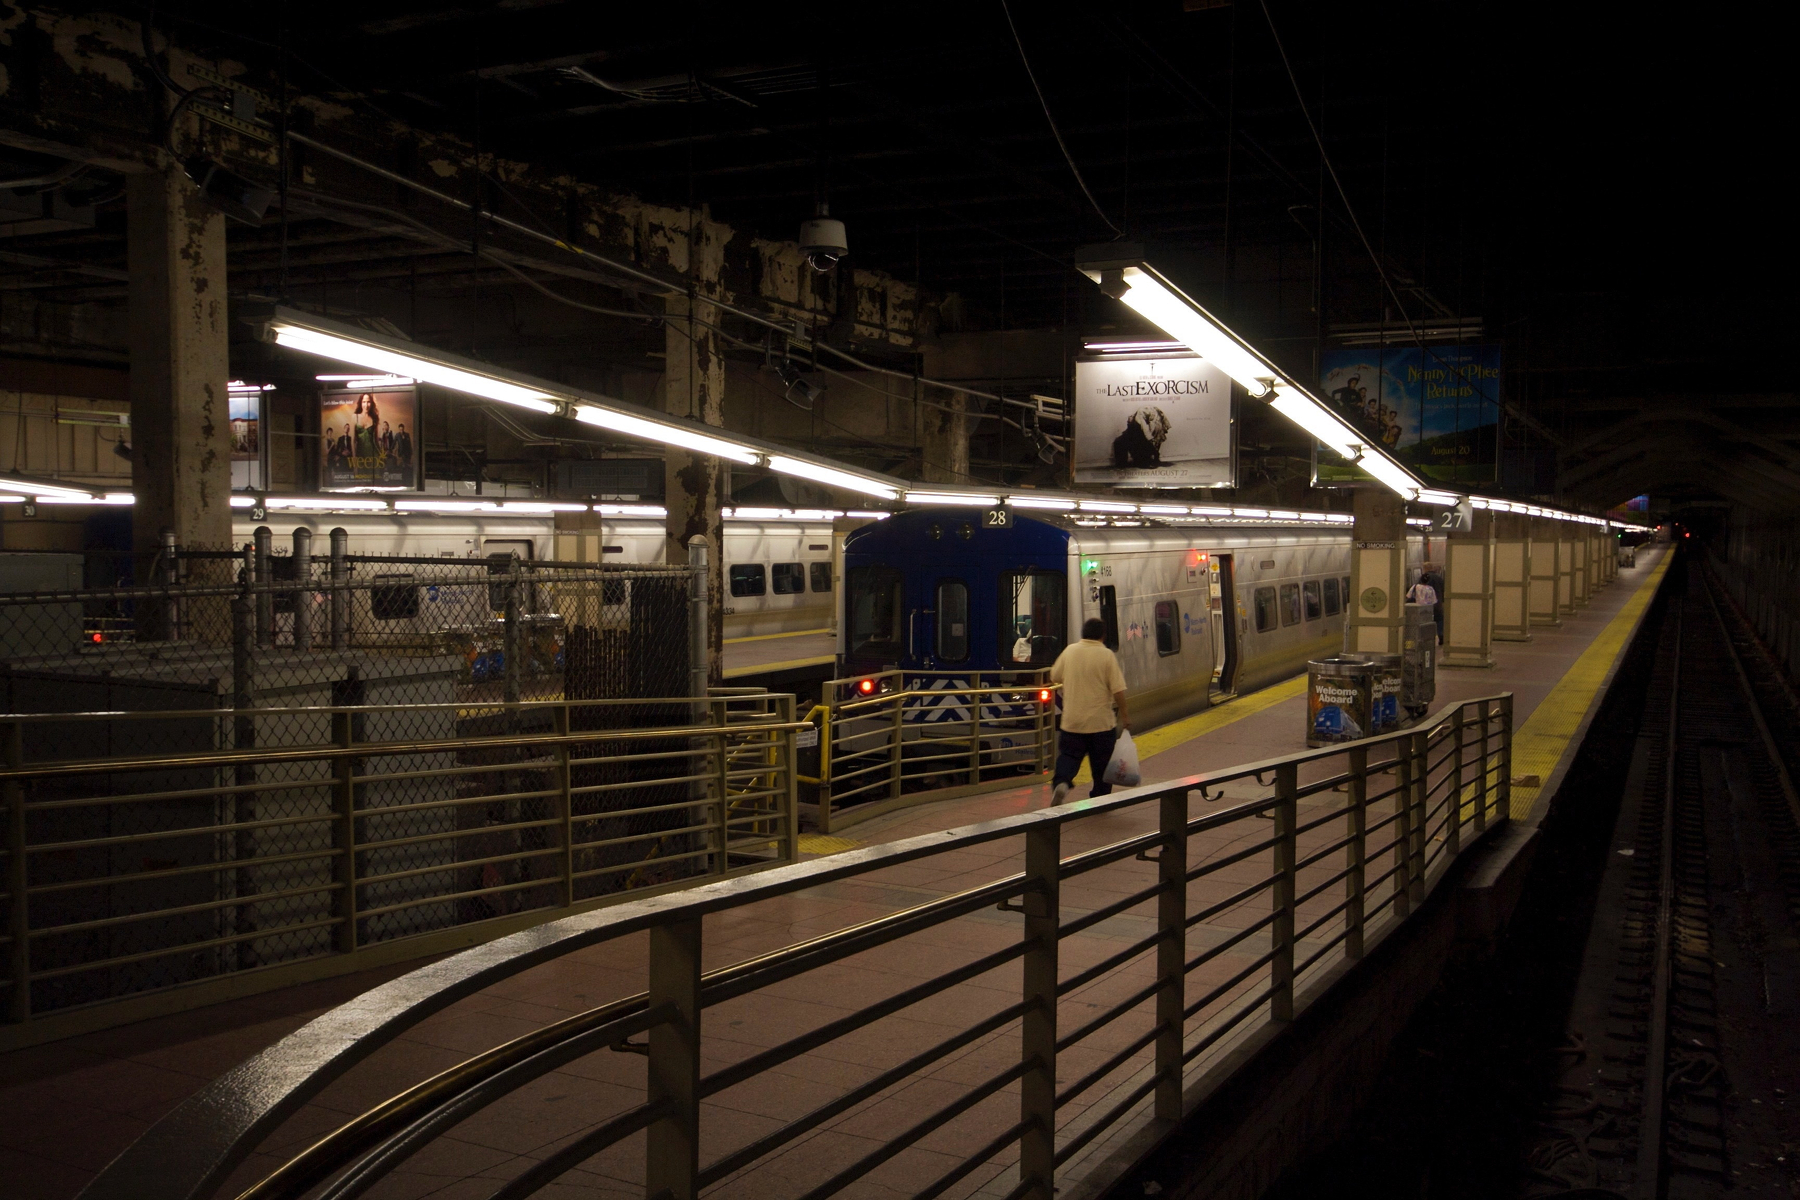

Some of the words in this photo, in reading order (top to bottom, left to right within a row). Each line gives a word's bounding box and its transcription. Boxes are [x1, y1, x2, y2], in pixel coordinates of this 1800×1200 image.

[1407, 364, 1447, 384] Nanny
[1107, 384, 1136, 397] LAST
[1136, 379, 1209, 396] EXORCISM
[1426, 382, 1473, 400] Returns
[1431, 446, 1457, 456] August
[1458, 445, 1471, 455] 20
[1150, 469, 1178, 477] AUGUST
[24, 505, 35, 516] 30
[252, 508, 264, 520] 29
[988, 510, 1006, 526] 28
[1441, 511, 1463, 528] 27
[1315, 685, 1358, 696] Welcome
[1318, 693, 1353, 704] Aboard
